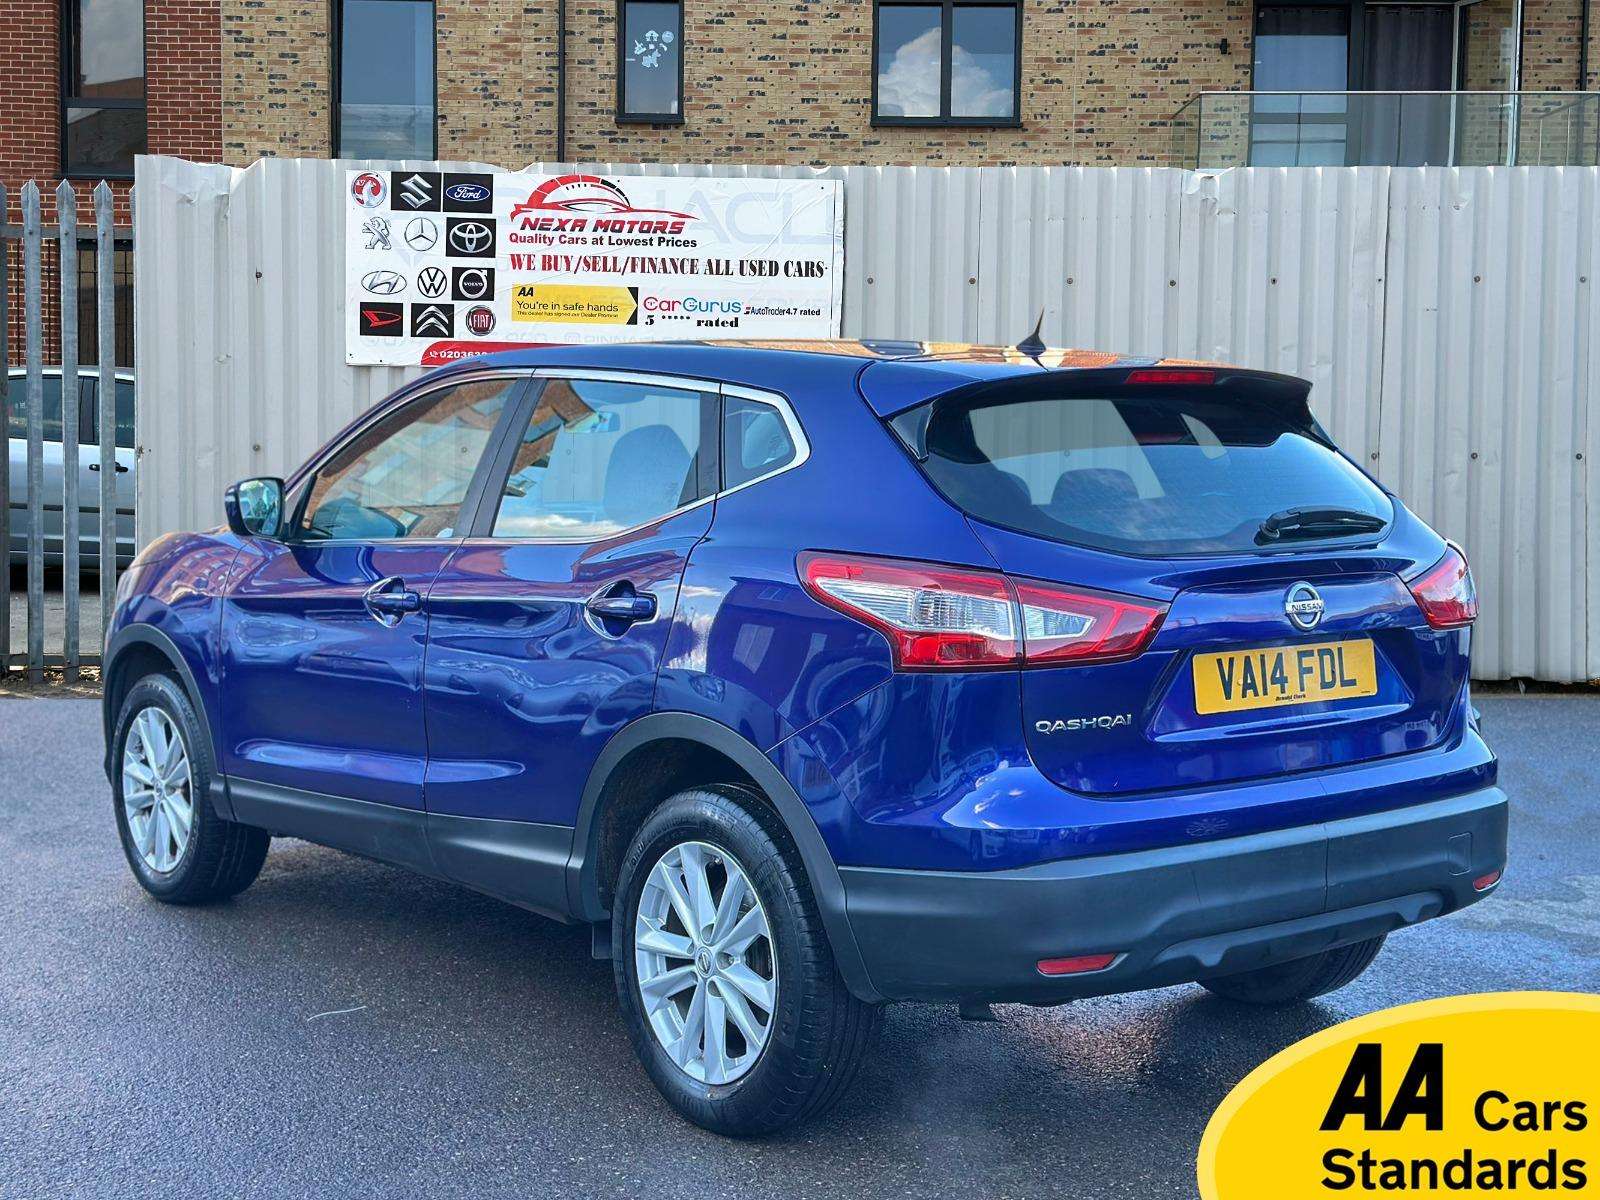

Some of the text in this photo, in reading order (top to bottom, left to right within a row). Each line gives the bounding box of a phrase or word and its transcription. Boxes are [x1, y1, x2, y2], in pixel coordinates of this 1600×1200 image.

[454, 186, 482, 199] Ford
[519, 217, 685, 235] NEXA MOTORS
[509, 232, 697, 248] Quality Cars at Lowest Prices
[510, 253, 536, 271] WE
[703, 258, 734, 276] ALL
[739, 259, 779, 278] USED
[783, 260, 825, 278] CARS
[517, 286, 534, 297] AA
[516, 301, 619, 312] You're in safe hands
[643, 296, 742, 313] CarGurus
[799, 308, 821, 316] rated
[473, 314, 489, 328] FIAT
[645, 315, 739, 328] 5 rated
[1291, 601, 1324, 613] NISSAN
[1216, 646, 1357, 700] VA14 FDL
[1035, 714, 1133, 734] QASHQAI
